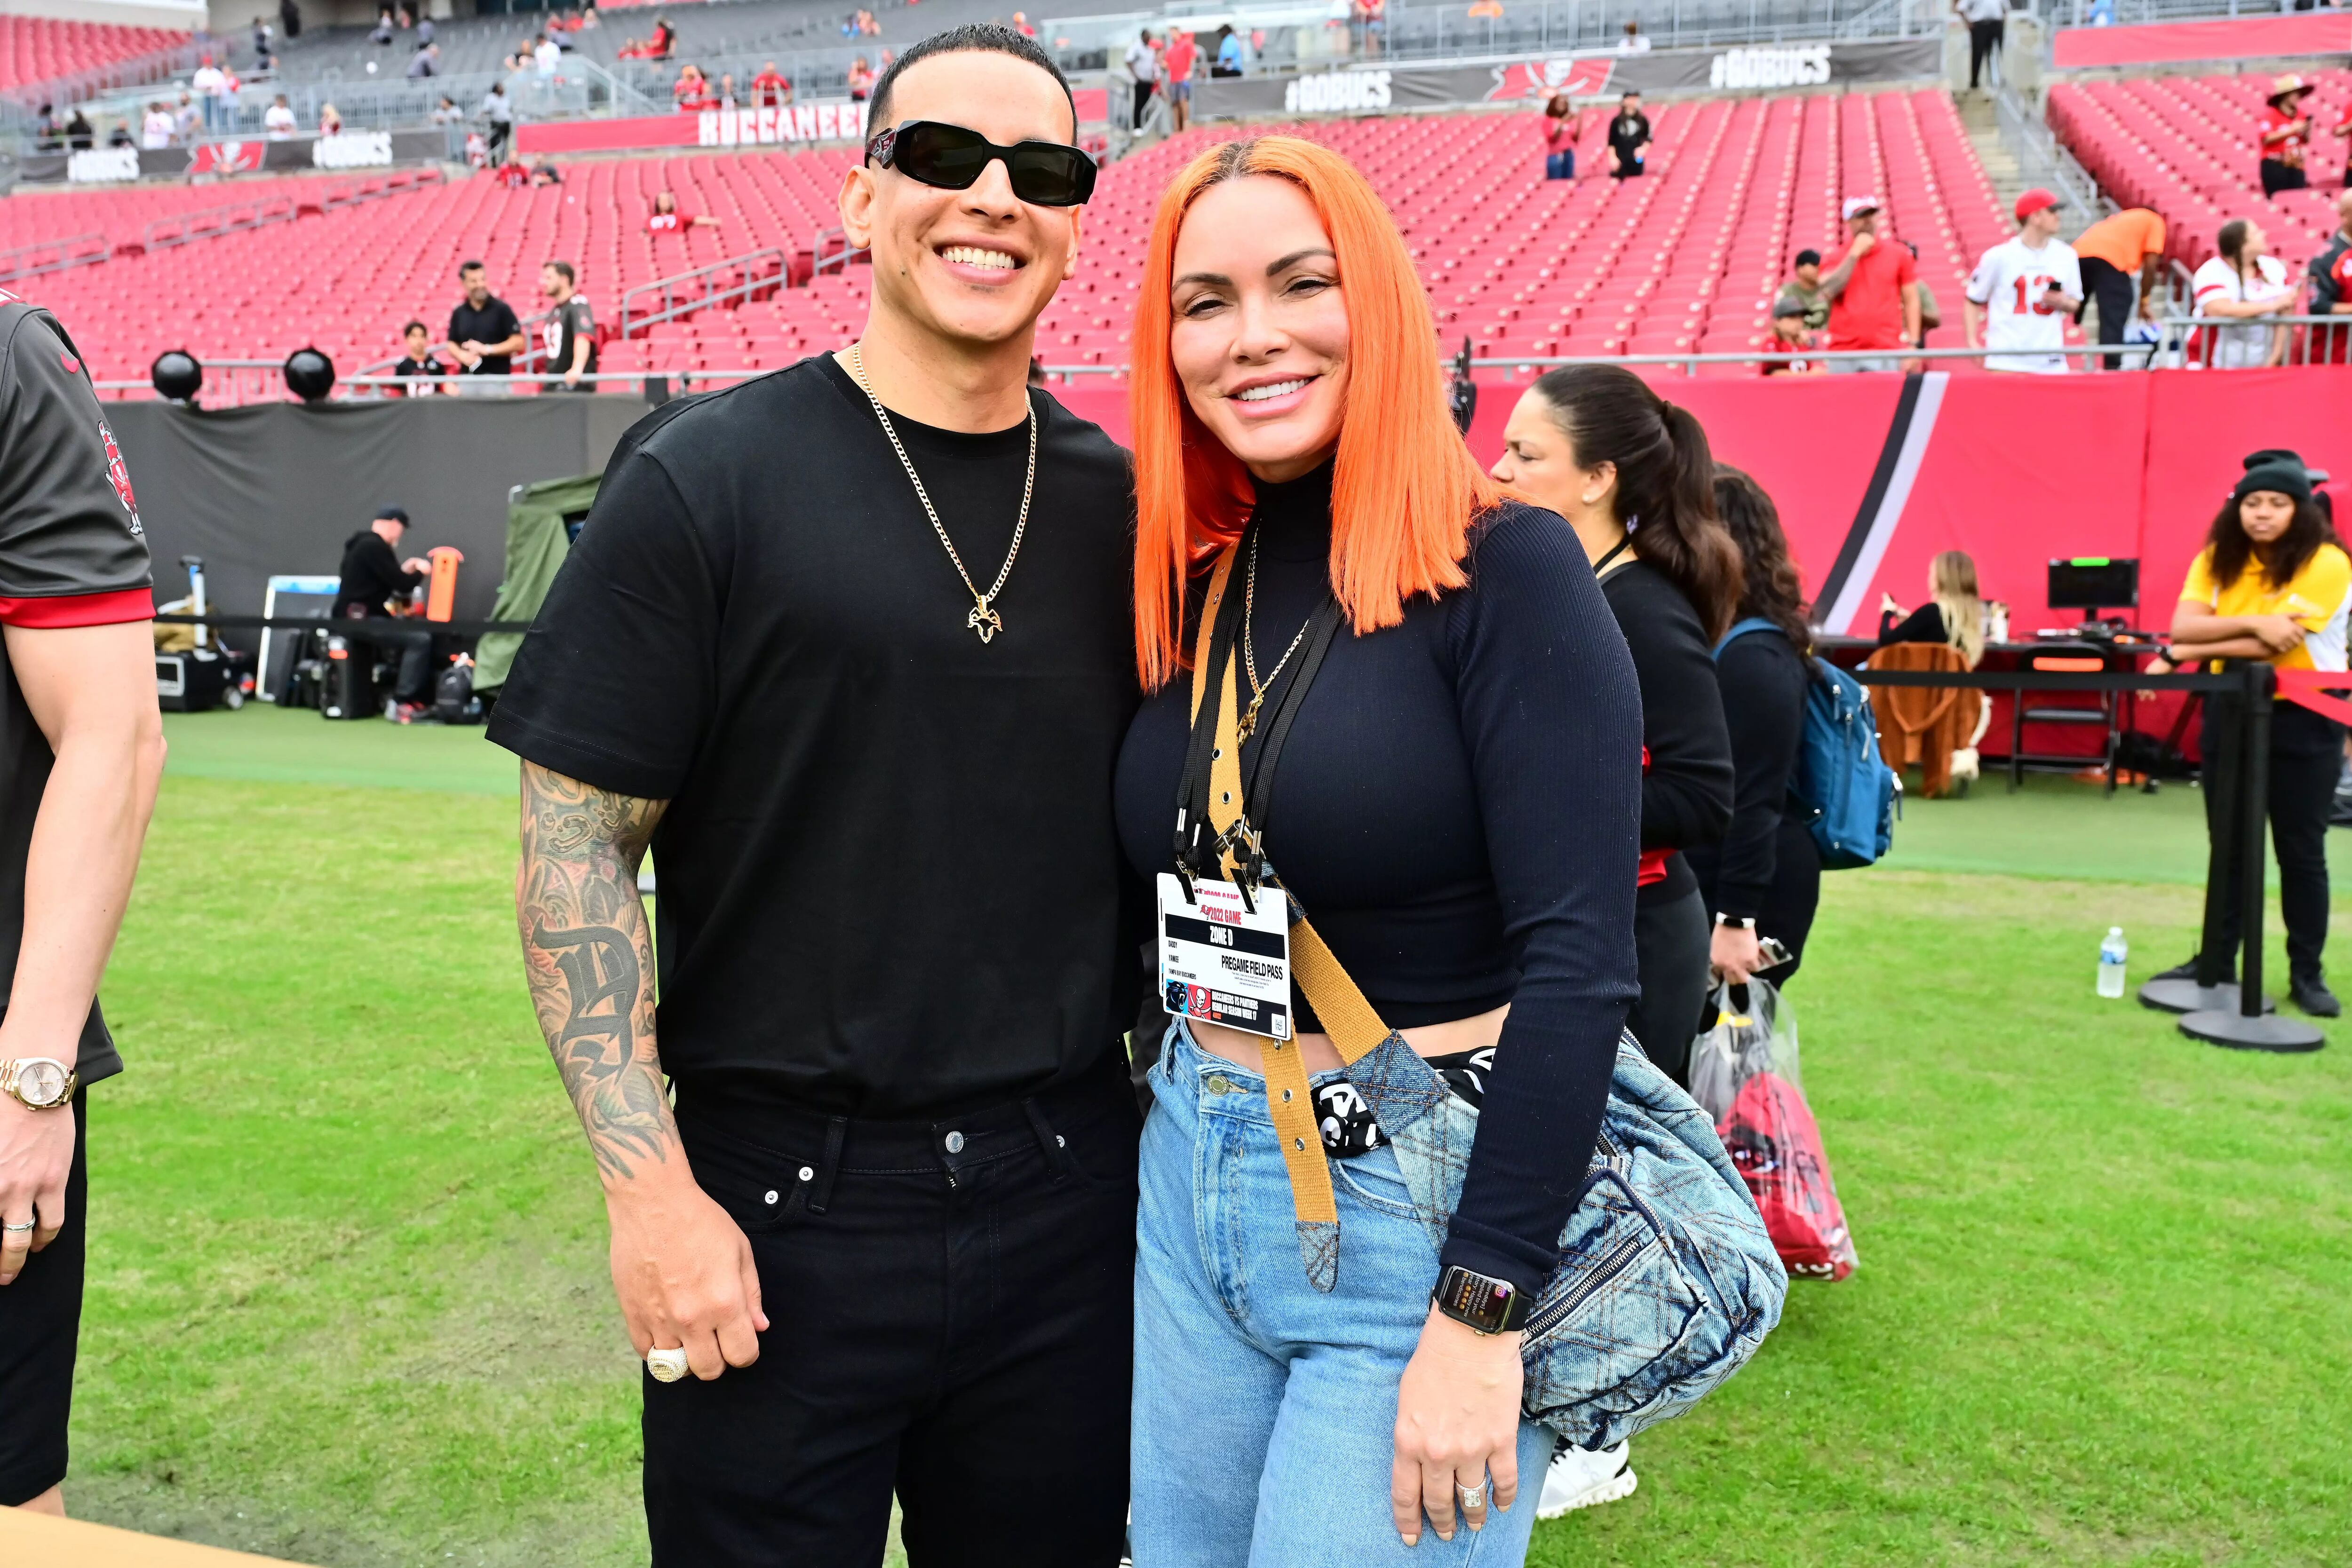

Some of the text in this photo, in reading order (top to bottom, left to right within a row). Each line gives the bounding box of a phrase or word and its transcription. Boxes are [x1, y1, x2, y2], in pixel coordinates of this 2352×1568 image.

[1709, 45, 1832, 89] #GOBUCS
[1285, 70, 1392, 112] #GOBUCS
[1210, 907, 1241, 925] 2022 GAME
[1210, 926, 1233, 946] ZONE D
[1168, 954, 1179, 963] YANKEE
[1222, 955, 1249, 973] PREGAME
[1250, 961, 1266, 976] FIELD
[1267, 964, 1283, 980] PASS
[1212, 991, 1258, 1010] BUCCANEERS VS PANTHERS
[1212, 1001, 1228, 1014] REGULAR
[1228, 1005, 1242, 1017] SEASON
[1242, 1008, 1253, 1020] WEEK
[1253, 1011, 1257, 1021] 17
[1453, 1277, 1467, 1307] bendiciones
[1466, 1290, 1476, 1306] Happy
[1477, 1278, 1487, 1299] Replied
